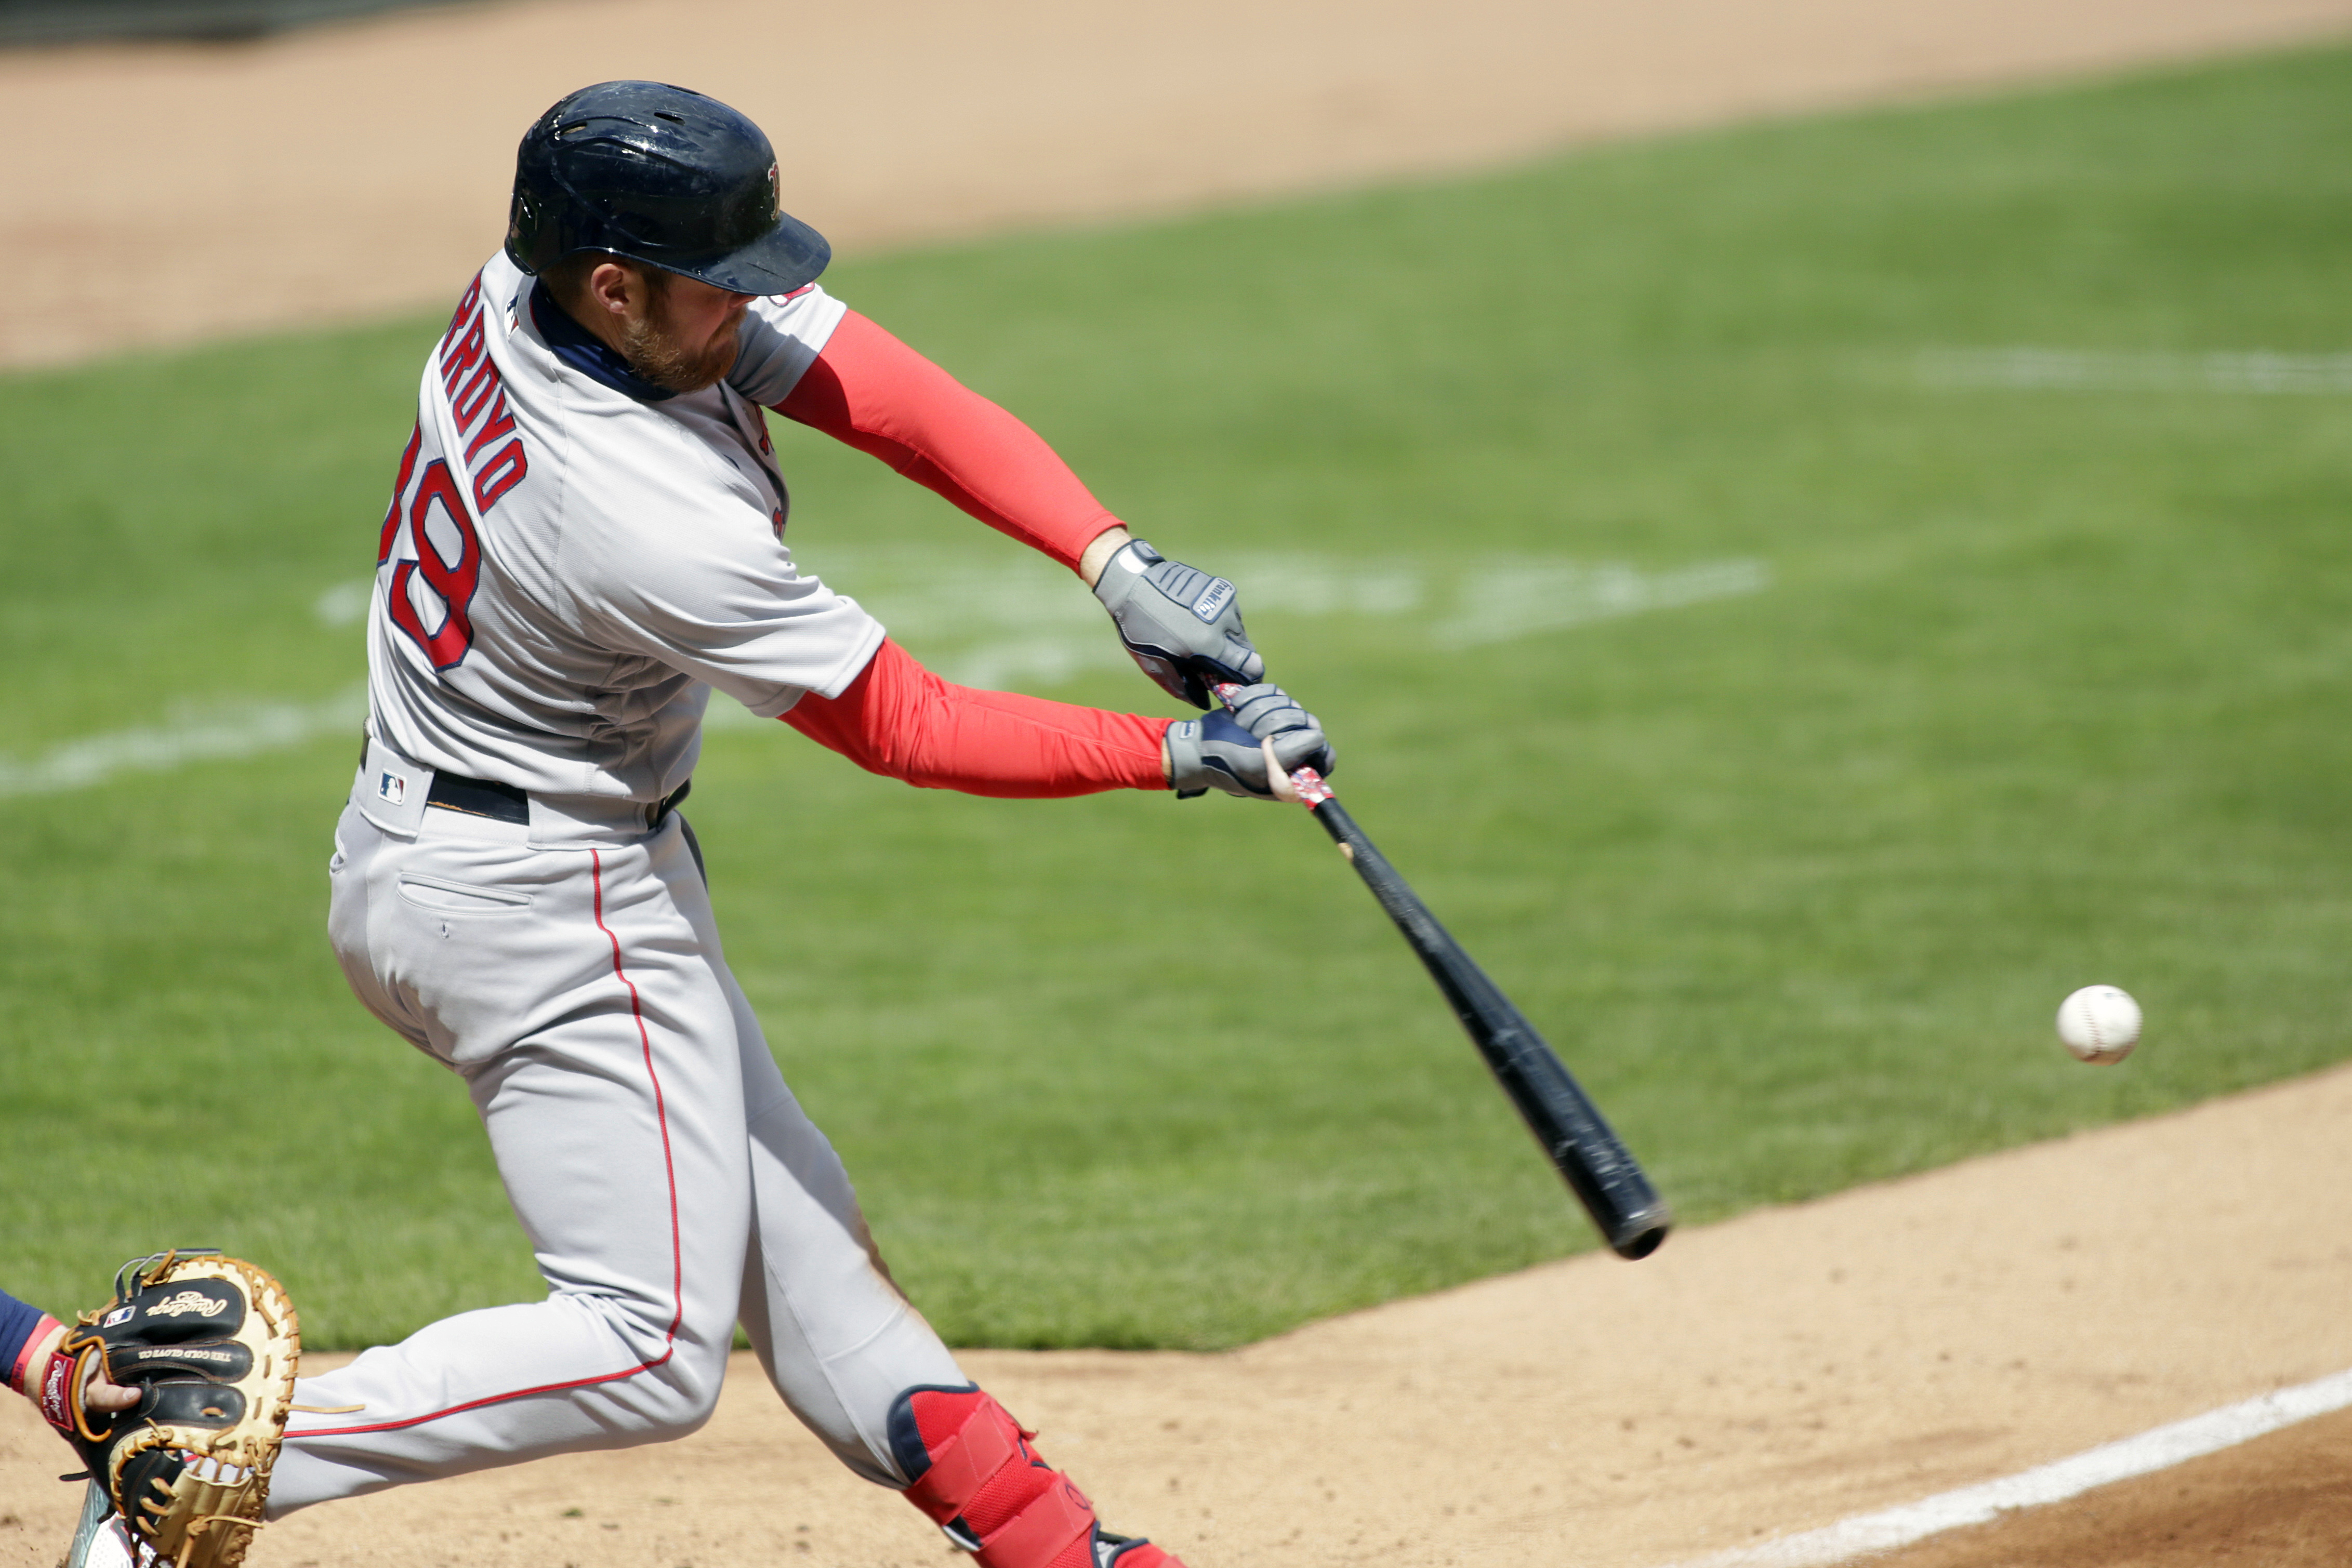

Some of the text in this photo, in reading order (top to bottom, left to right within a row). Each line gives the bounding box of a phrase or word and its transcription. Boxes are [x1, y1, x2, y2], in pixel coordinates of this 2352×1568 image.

[146, 1296, 228, 1317] Rawlings
[152, 1349, 184, 1358] GLOVE
[184, 1350, 210, 1359] GOLD
[210, 1351, 232, 1362] THE
